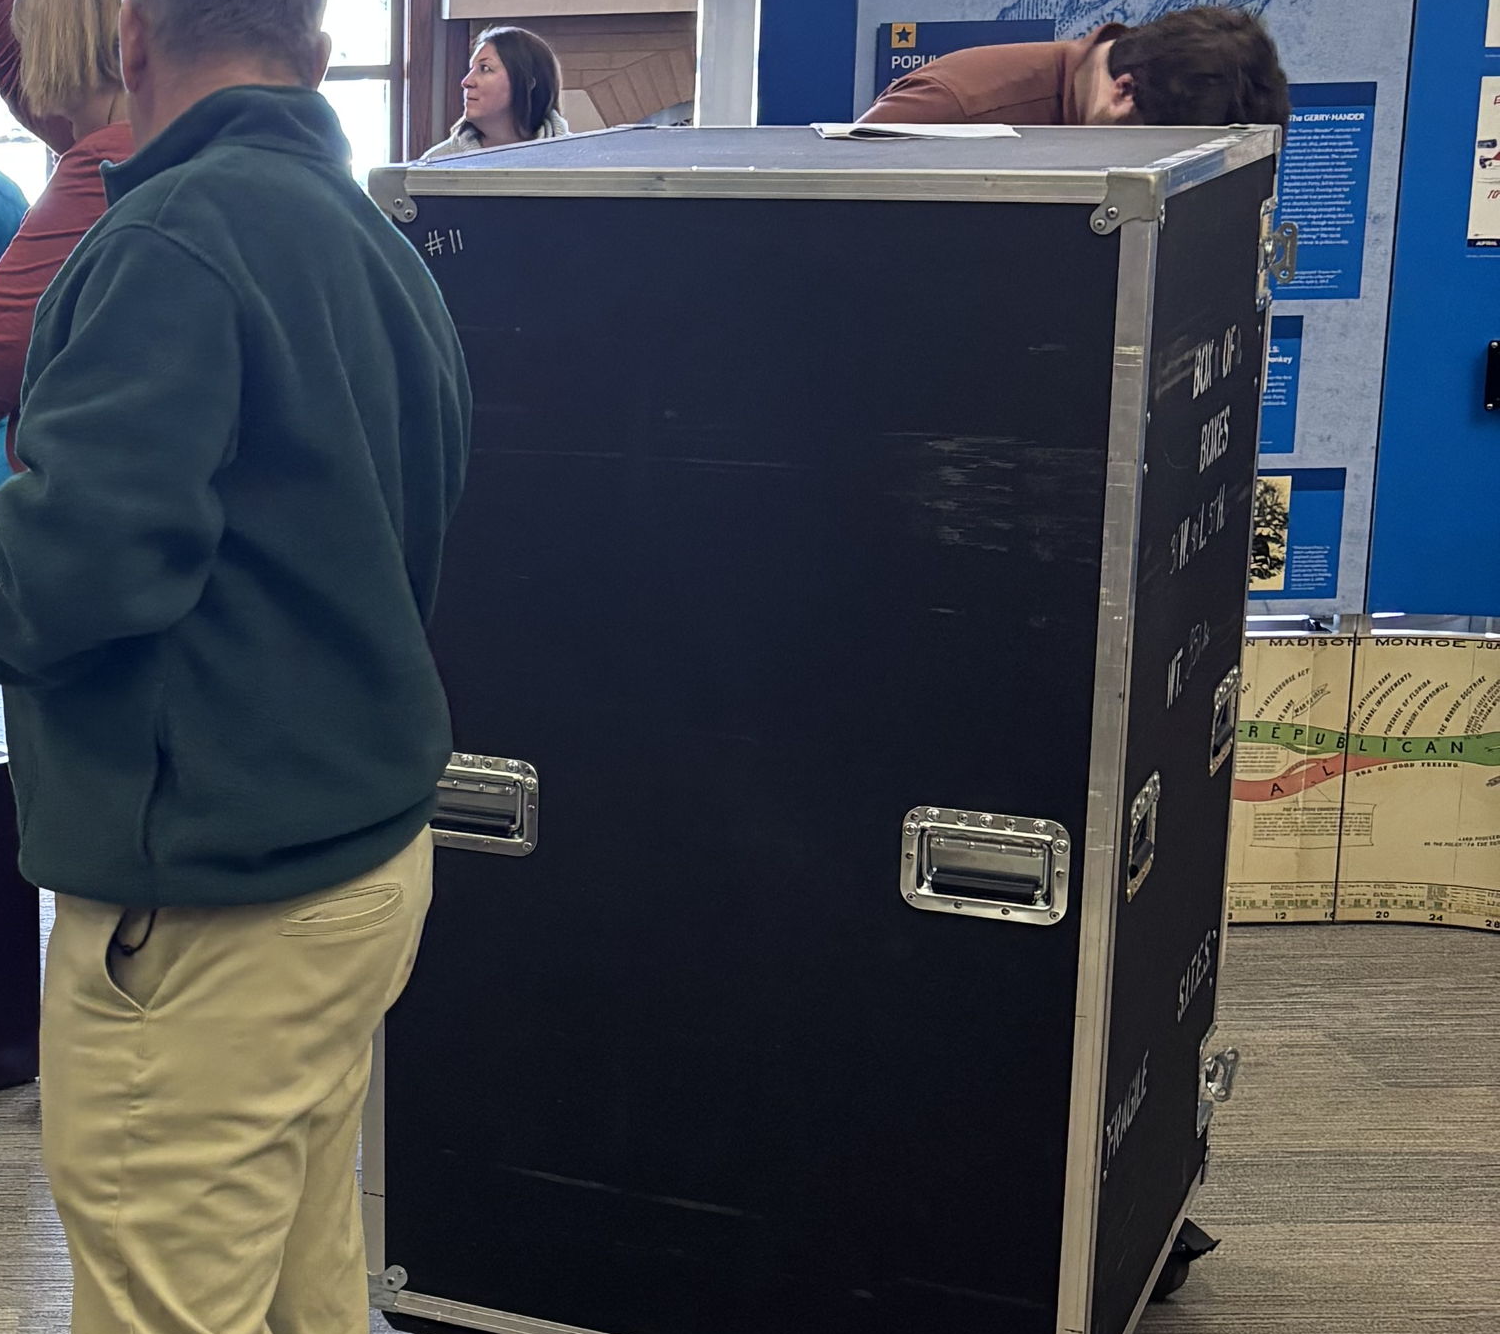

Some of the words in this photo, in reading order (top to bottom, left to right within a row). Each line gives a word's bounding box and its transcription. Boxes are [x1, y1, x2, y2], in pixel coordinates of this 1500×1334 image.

[424, 229, 464, 257] #11
[1192, 338, 1215, 401] BOX
[1222, 324, 1237, 380] OF
[1199, 405, 1231, 475] BOXES
[1268, 638, 1362, 648] MADISON
[1375, 638, 1467, 648] MONROE
[1274, 911, 1287, 920] 12
[1375, 910, 1390, 919] 20
[1428, 913, 1444, 922] 24
[1107, 1049, 1149, 1157] FRAGILE
